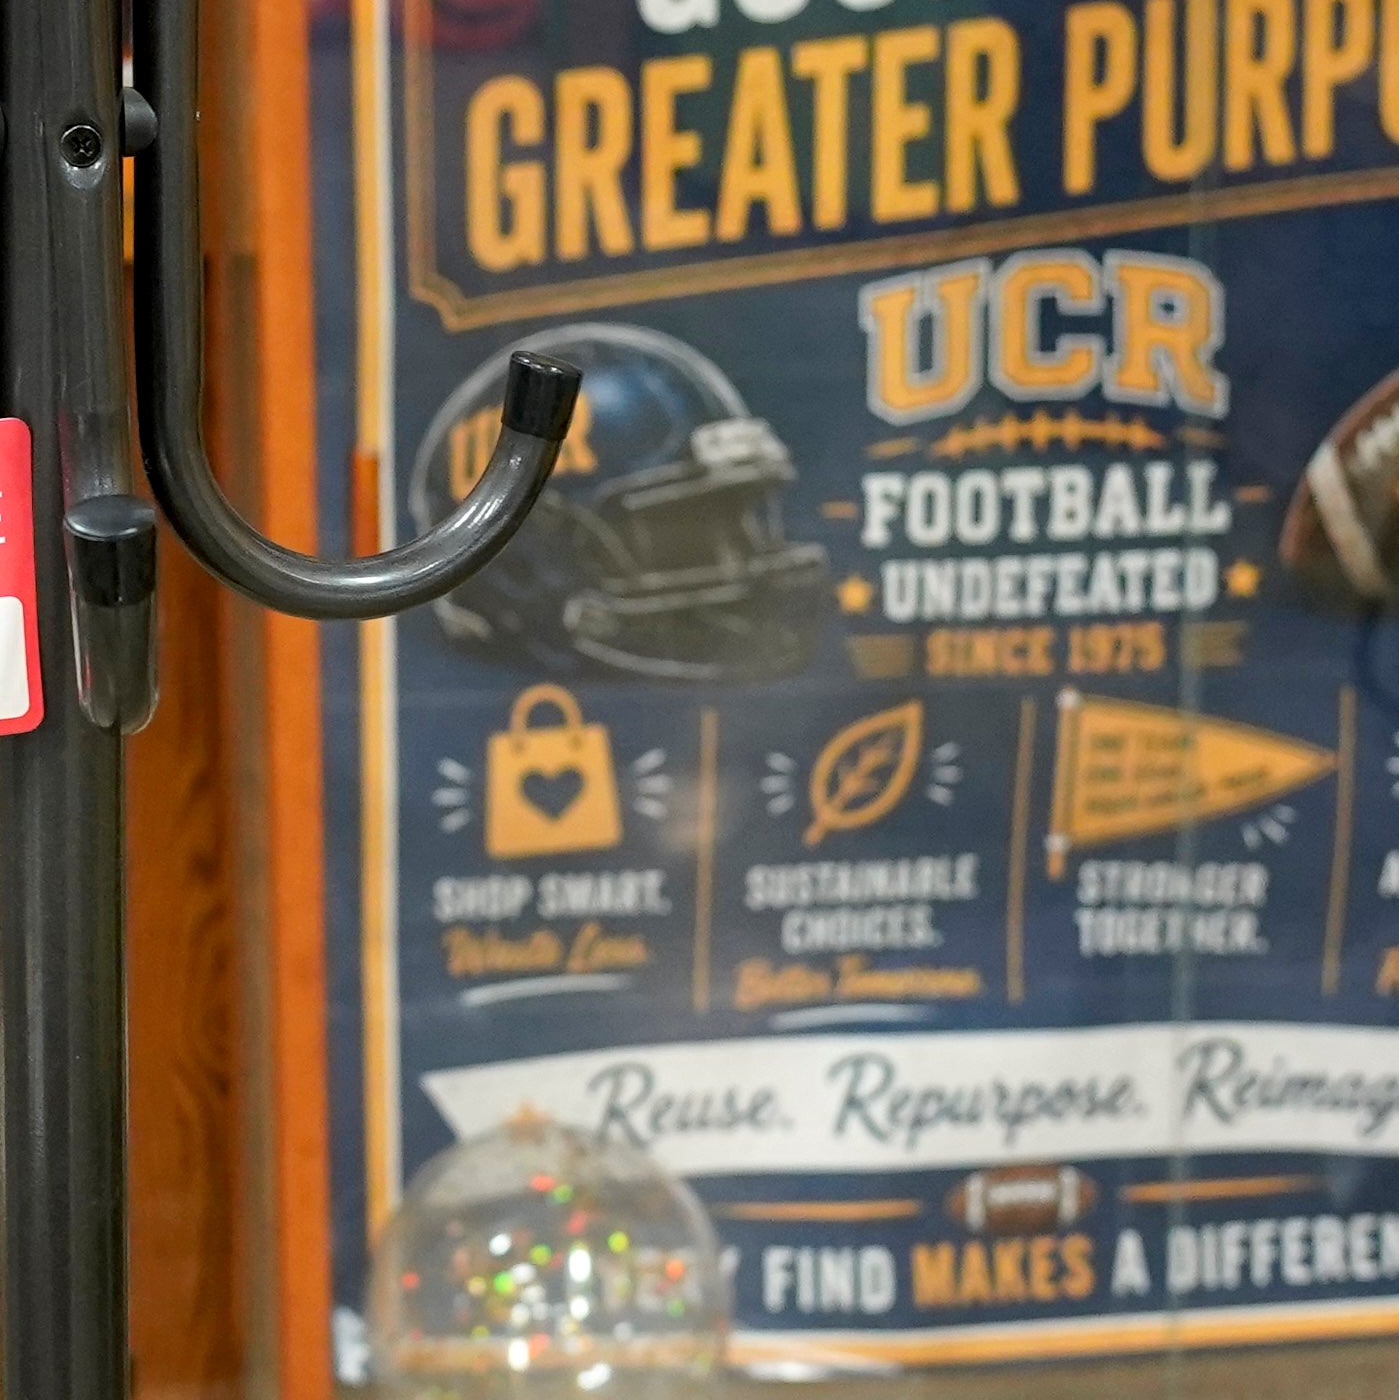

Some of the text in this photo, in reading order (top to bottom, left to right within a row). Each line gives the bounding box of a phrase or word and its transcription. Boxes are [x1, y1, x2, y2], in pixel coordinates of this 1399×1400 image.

[466, 16, 1021, 273] GREATER
[858, 248, 1229, 426] UCR
[861, 461, 1231, 549] FOOTBALL
[882, 546, 1218, 623] UNDEFEATED
[925, 620, 1166, 678] SINCE 1975
[433, 868, 673, 923] SHOP SMART.
[745, 853, 978, 911] SUSTAINABLE
[1077, 860, 1268, 906] STRONGER
[781, 904, 945, 954] CHOICES.
[588, 1036, 1399, 1150] Reuse. Repurpose. Reimag
[761, 1244, 897, 1314] FIND
[911, 1231, 1095, 1308] MAKES
[1110, 1227, 1151, 1298] A
